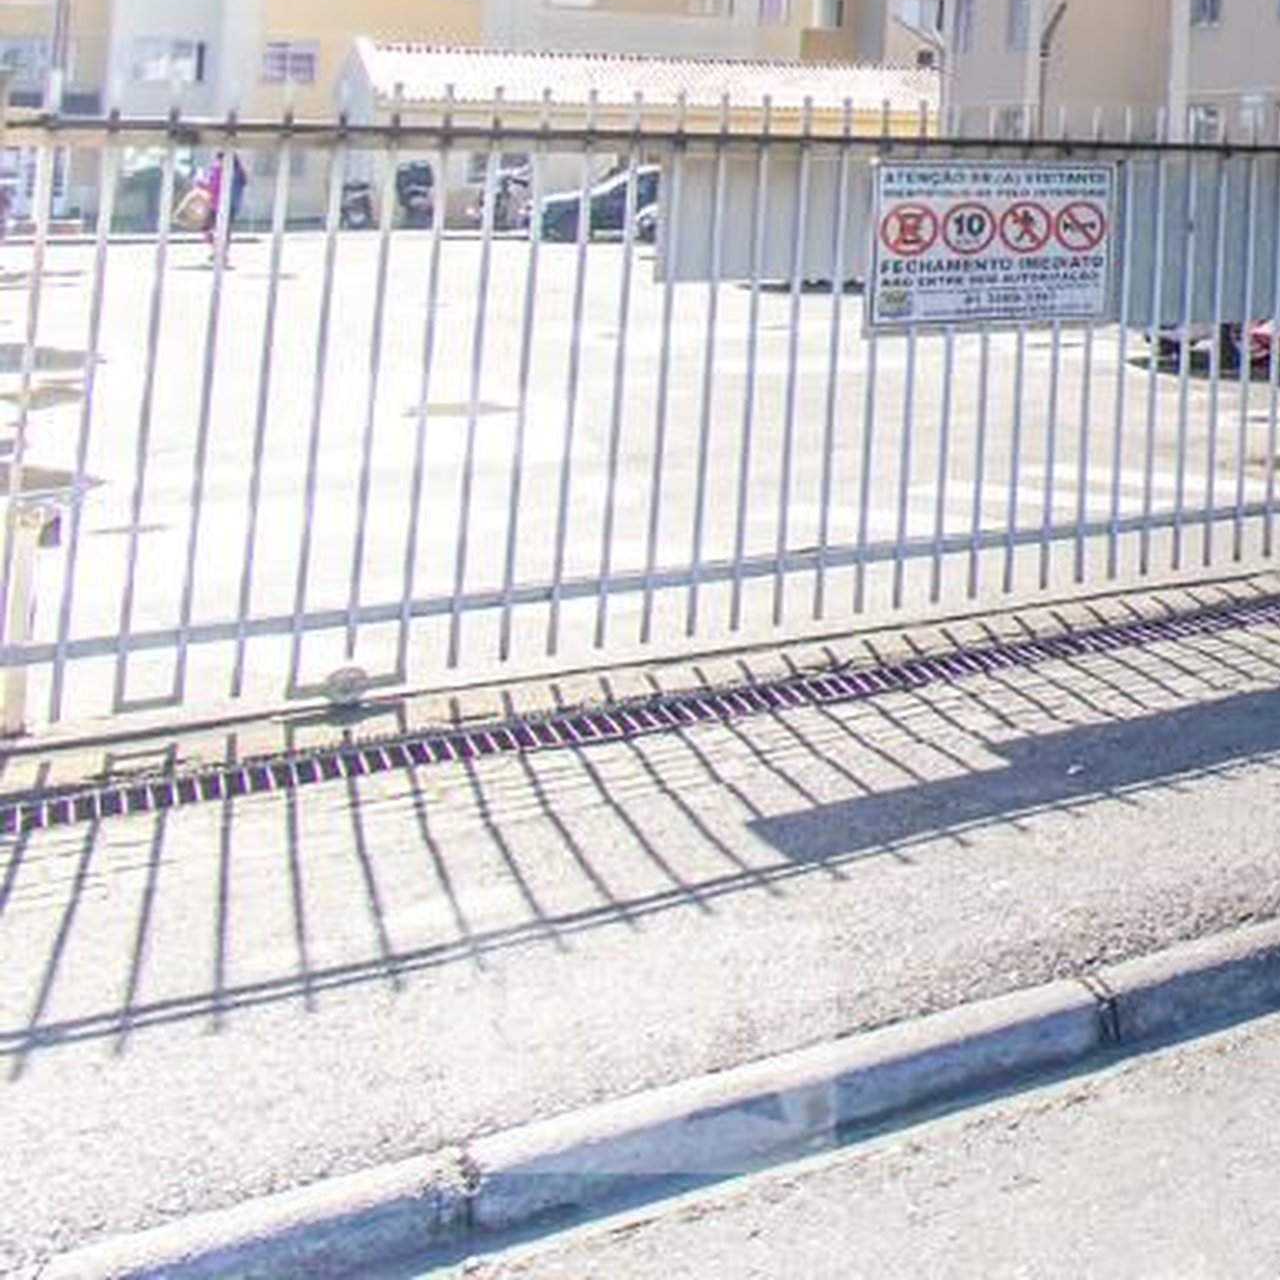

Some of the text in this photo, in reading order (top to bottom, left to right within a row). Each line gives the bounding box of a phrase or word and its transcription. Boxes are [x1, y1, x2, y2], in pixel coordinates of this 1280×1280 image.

[885, 170, 967, 186] ATENÇÃO
[953, 213, 986, 237] 10
[880, 258, 1013, 274] FECHAMENTO
